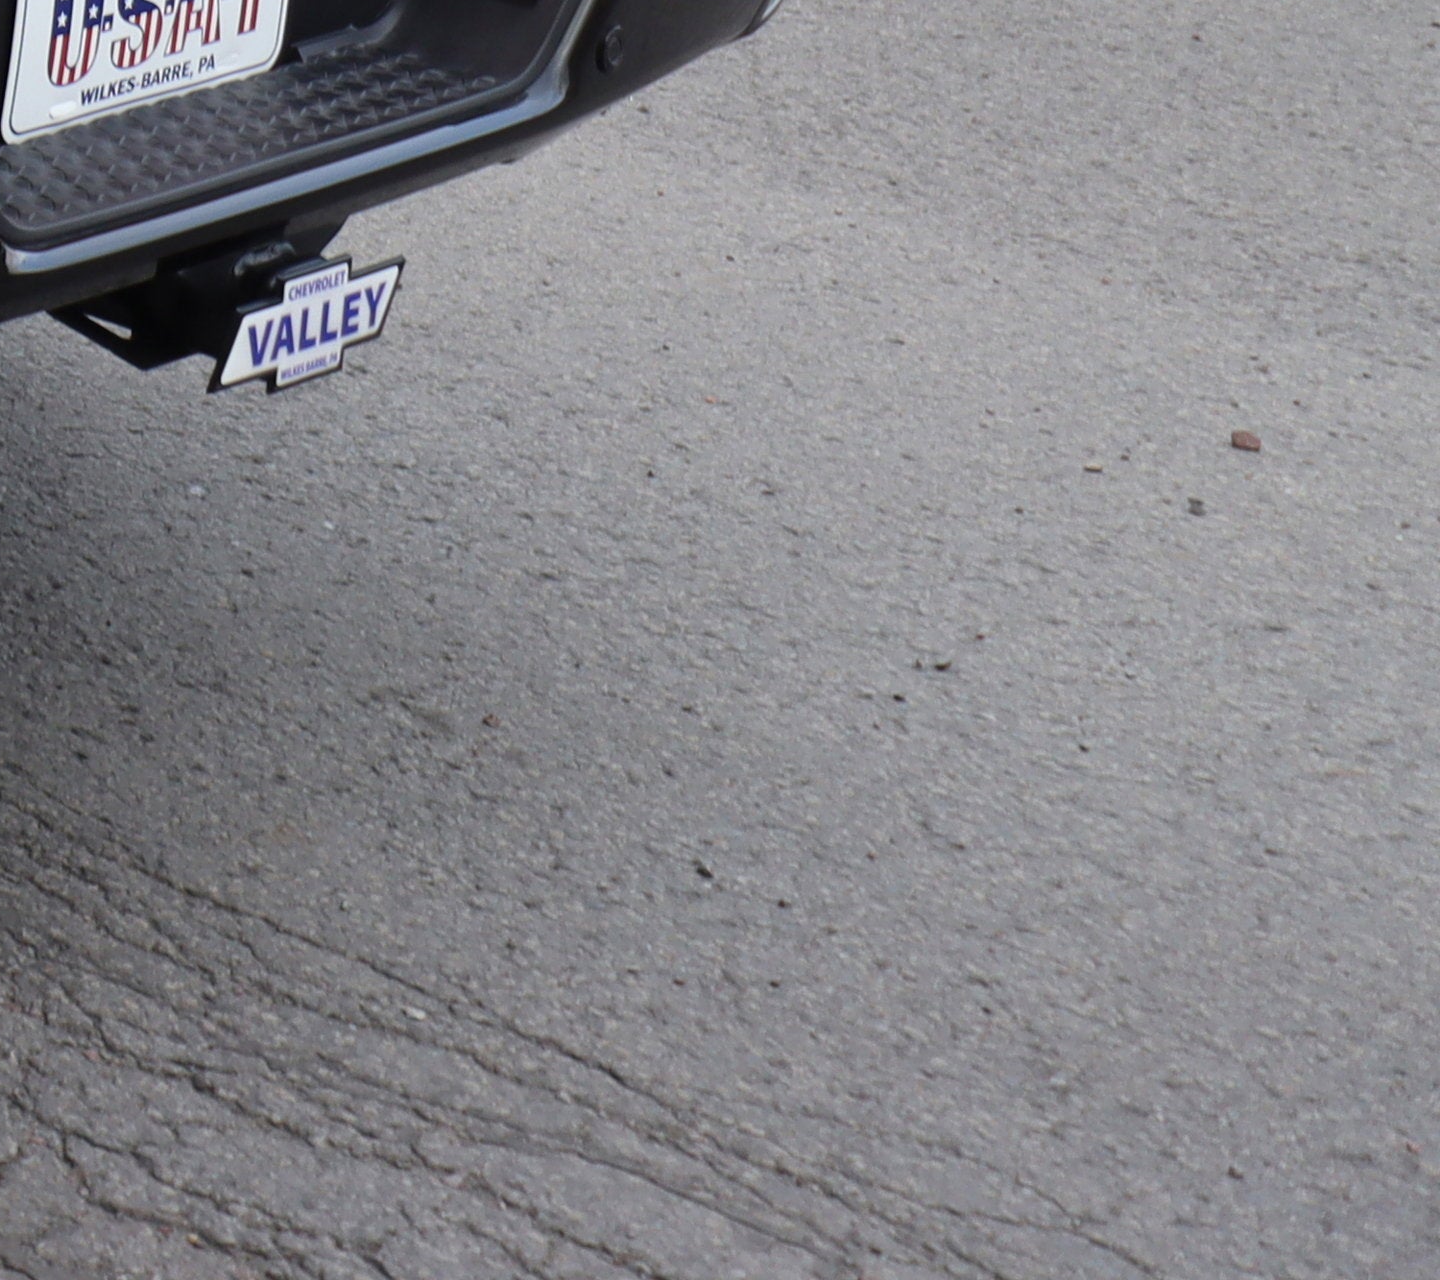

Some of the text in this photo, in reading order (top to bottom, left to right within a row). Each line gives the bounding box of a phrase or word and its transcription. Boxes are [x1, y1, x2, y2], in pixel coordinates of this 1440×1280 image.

[80, 54, 216, 106] WILKES-BARRE, PA
[288, 269, 346, 301] CHEVROLET
[248, 281, 386, 367] VALLEY
